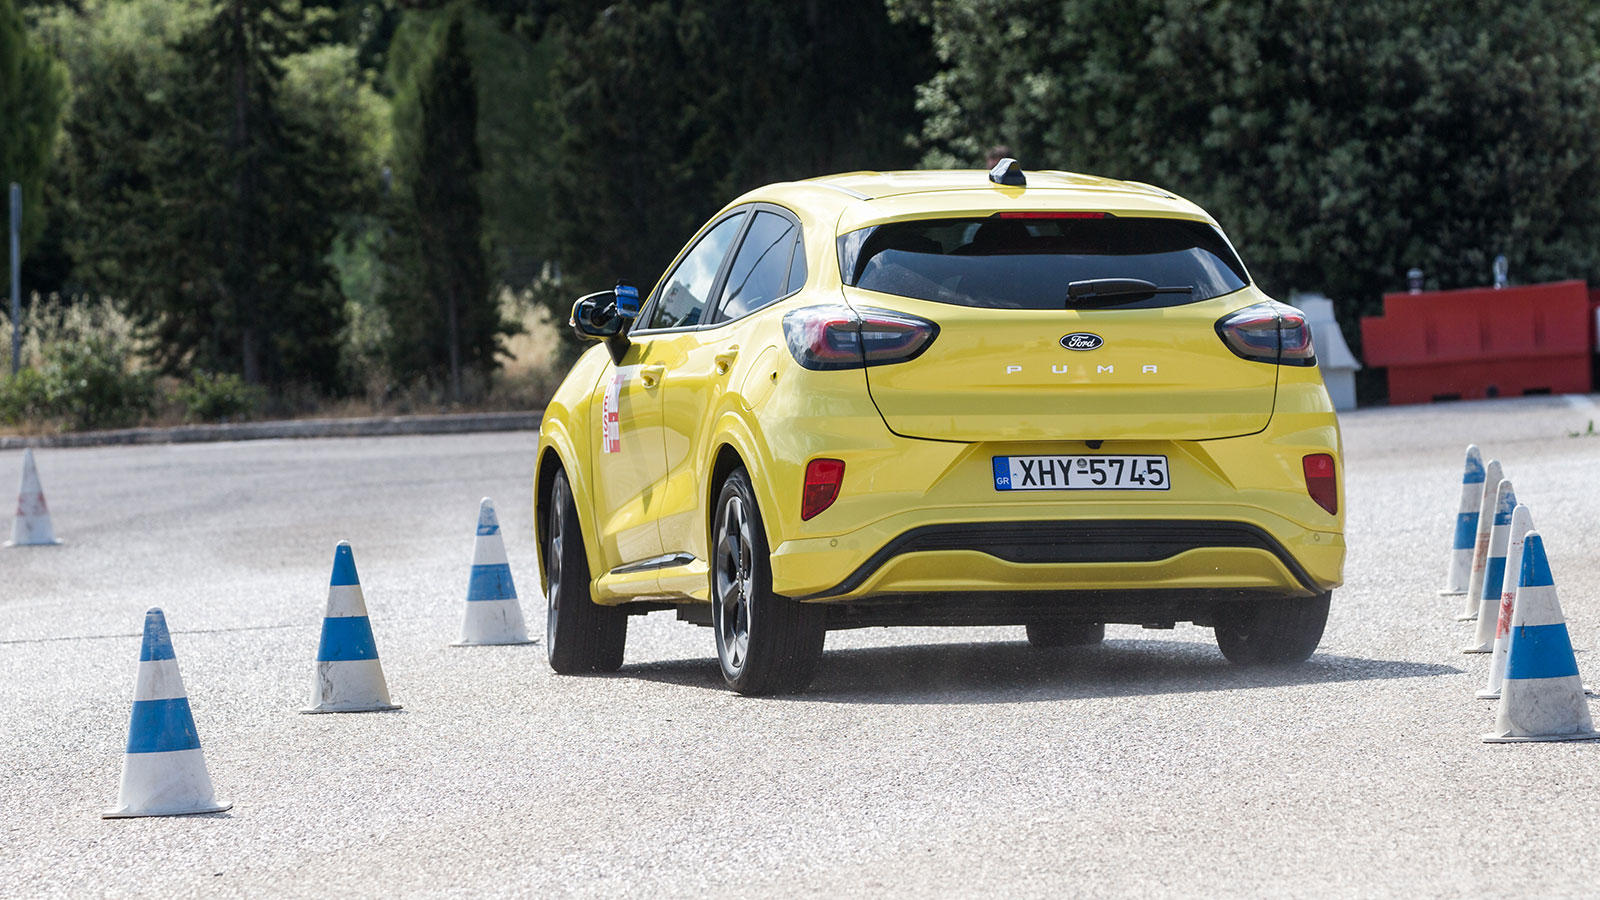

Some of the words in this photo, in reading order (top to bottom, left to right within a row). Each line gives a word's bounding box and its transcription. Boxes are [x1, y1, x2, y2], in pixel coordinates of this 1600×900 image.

[1068, 335, 1095, 348] Ford
[1006, 364, 1158, 374] PUMA
[1019, 459, 1164, 486] XHY-5745
[996, 477, 1010, 485] GR
